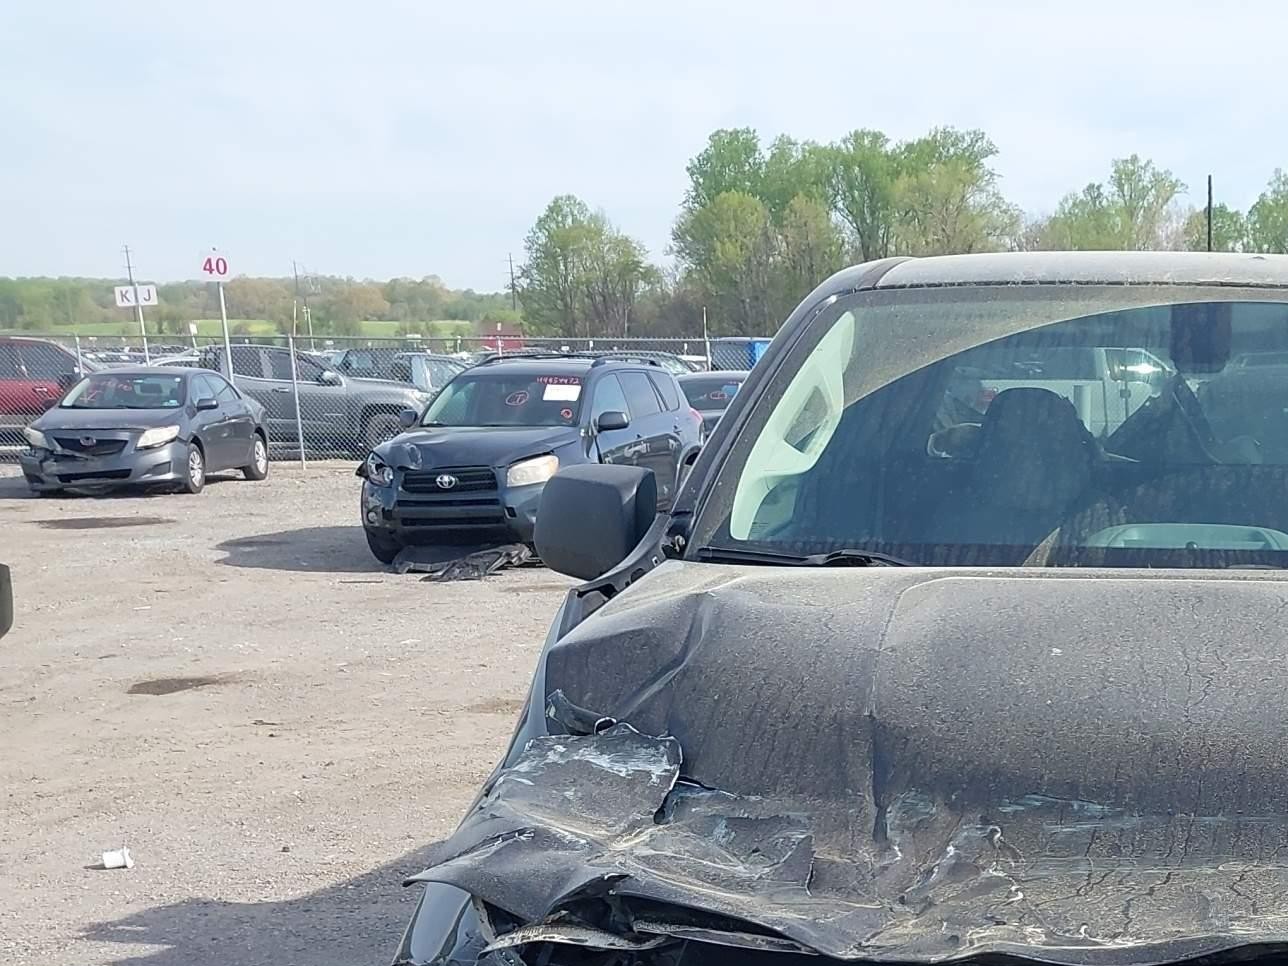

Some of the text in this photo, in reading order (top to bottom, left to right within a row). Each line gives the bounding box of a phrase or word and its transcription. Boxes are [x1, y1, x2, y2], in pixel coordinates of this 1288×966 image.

[203, 257, 228, 275] 40
[120, 289, 152, 303] K J
